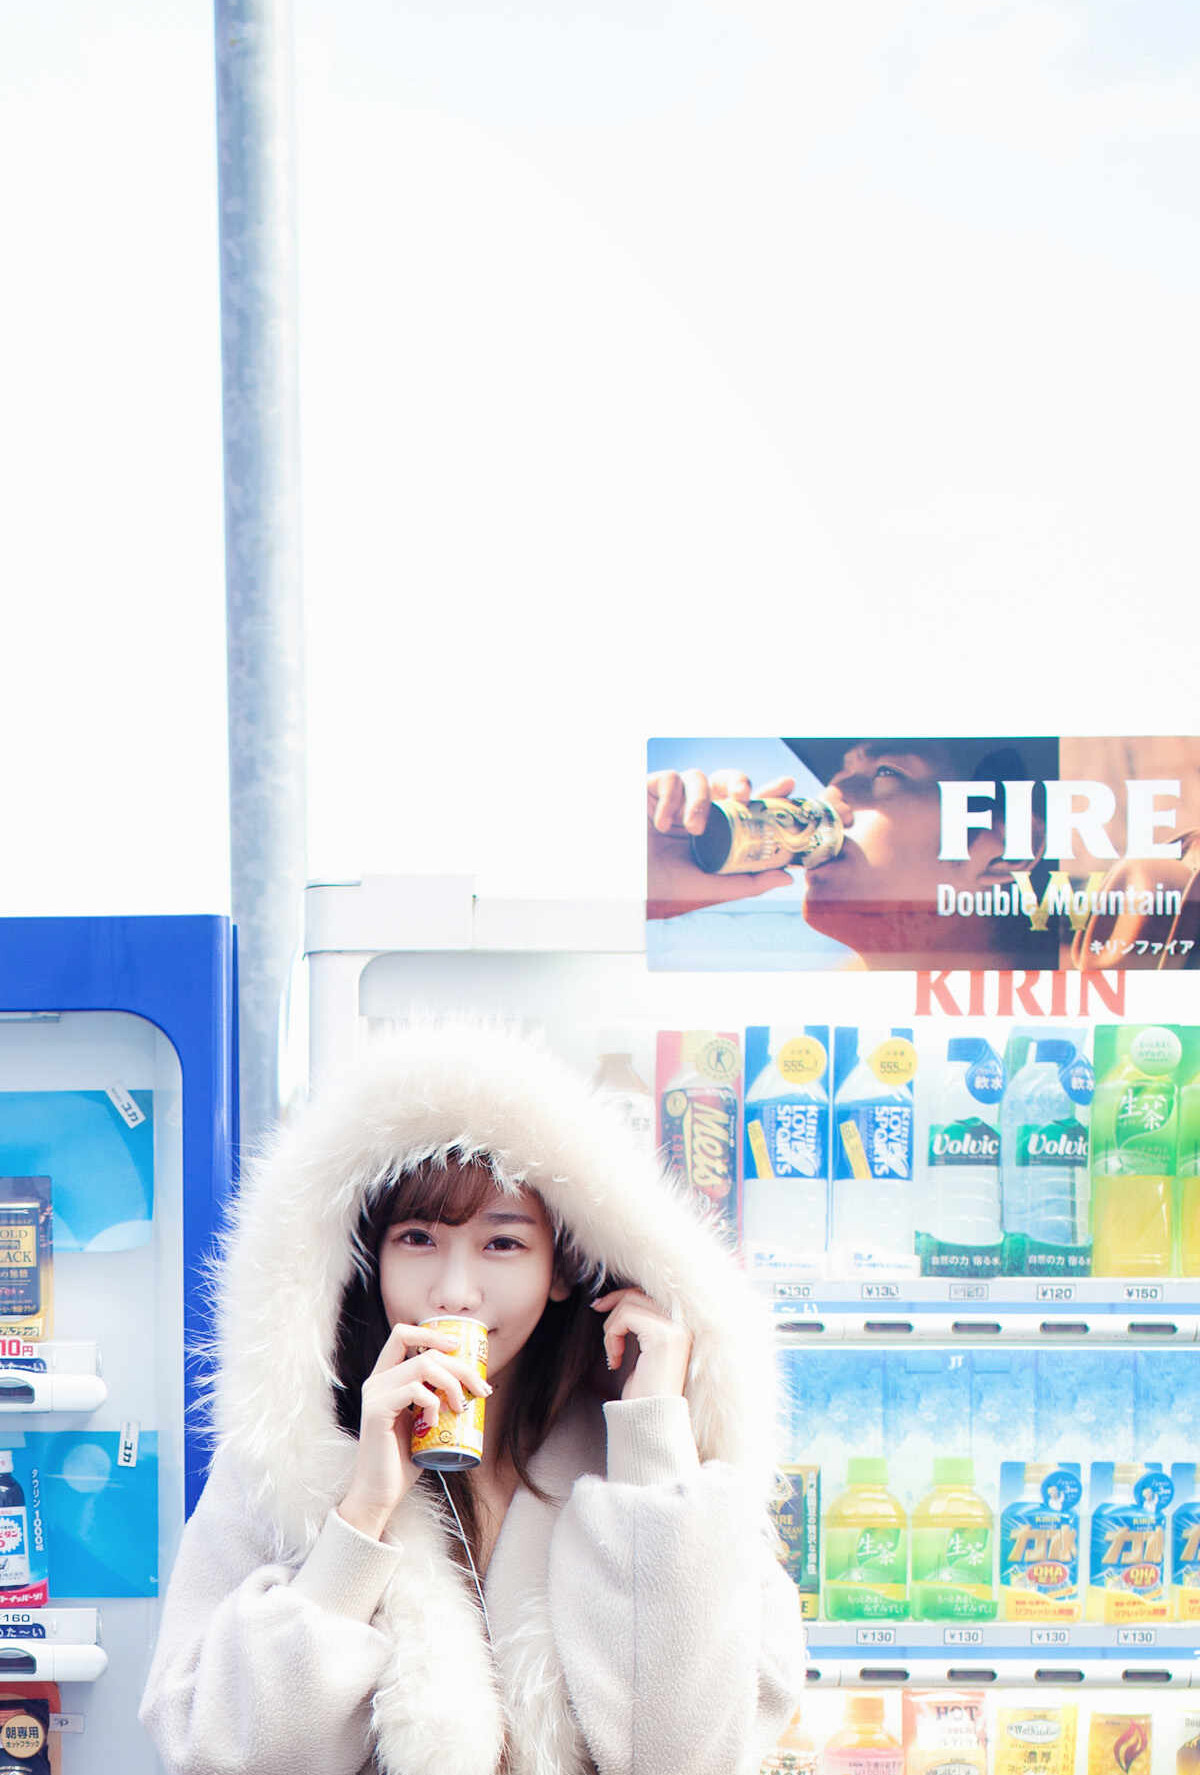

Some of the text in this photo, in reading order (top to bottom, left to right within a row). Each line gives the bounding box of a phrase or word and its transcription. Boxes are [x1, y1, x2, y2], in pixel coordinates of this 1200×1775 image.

[937, 780, 1183, 860] FIRE
[937, 883, 1182, 917] Double Mountain
[1089, 939, 1195, 955] キリンファイア
[913, 969, 1127, 1017] KIRIN
[1117, 1088, 1167, 1131] 生茶
[1040, 1287, 1158, 1299] ¥120 ¥150
[858, 1531, 895, 1567] 生茶
[949, 1631, 979, 1643] ¥130
[5, 1726, 40, 1741] 朝専用
